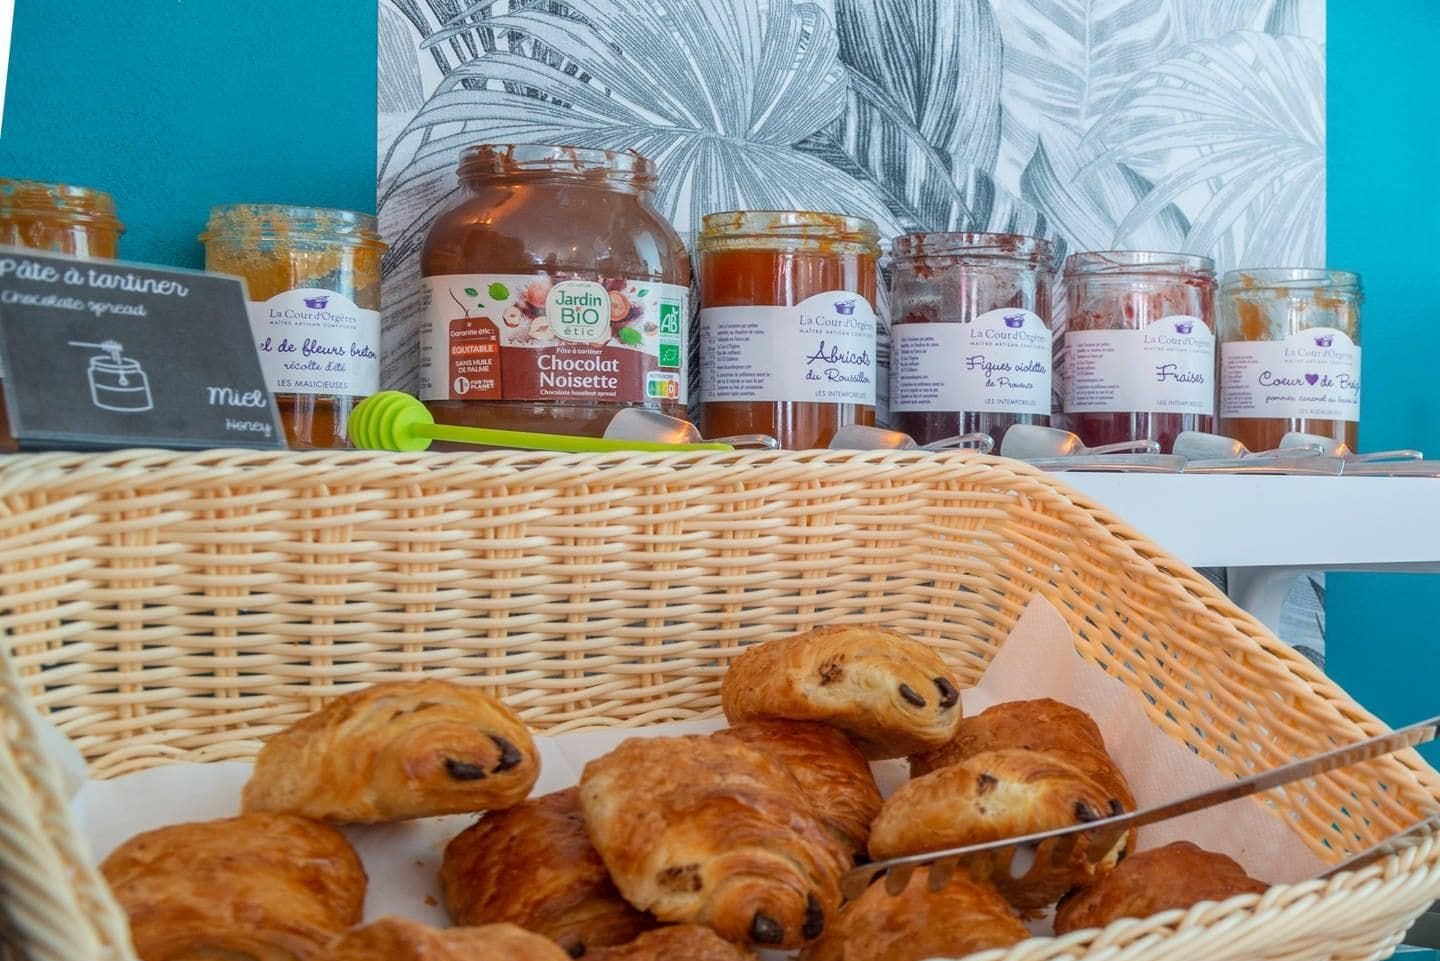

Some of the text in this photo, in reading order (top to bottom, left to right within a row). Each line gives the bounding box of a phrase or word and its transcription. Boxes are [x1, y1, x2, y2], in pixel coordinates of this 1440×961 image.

[0, 258, 190, 297] Pâte à tartiner
[0, 290, 148, 318] Chocolate spread
[555, 290, 602, 307] Jardin
[269, 309, 282, 319] La
[284, 309, 313, 320] Cour
[660, 307, 679, 333] AB
[799, 315, 813, 325] La
[815, 315, 842, 327] Cour
[970, 329, 983, 339] La
[985, 329, 1011, 340] Cour
[277, 338, 297, 353] de
[302, 338, 346, 357] fleurs
[806, 340, 871, 367] Abricots
[537, 355, 620, 373] Chocolat
[966, 355, 1012, 378] Figues
[539, 372, 618, 389] Noisette
[805, 369, 822, 382] du
[1155, 363, 1205, 384] Fraises
[1258, 371, 1304, 387] Coeur
[1320, 375, 1333, 387] de
[277, 379, 348, 390] LES MALICIEUSES
[985, 379, 996, 388] de
[206, 386, 267, 408] Miel
[225, 418, 272, 437] Honey
